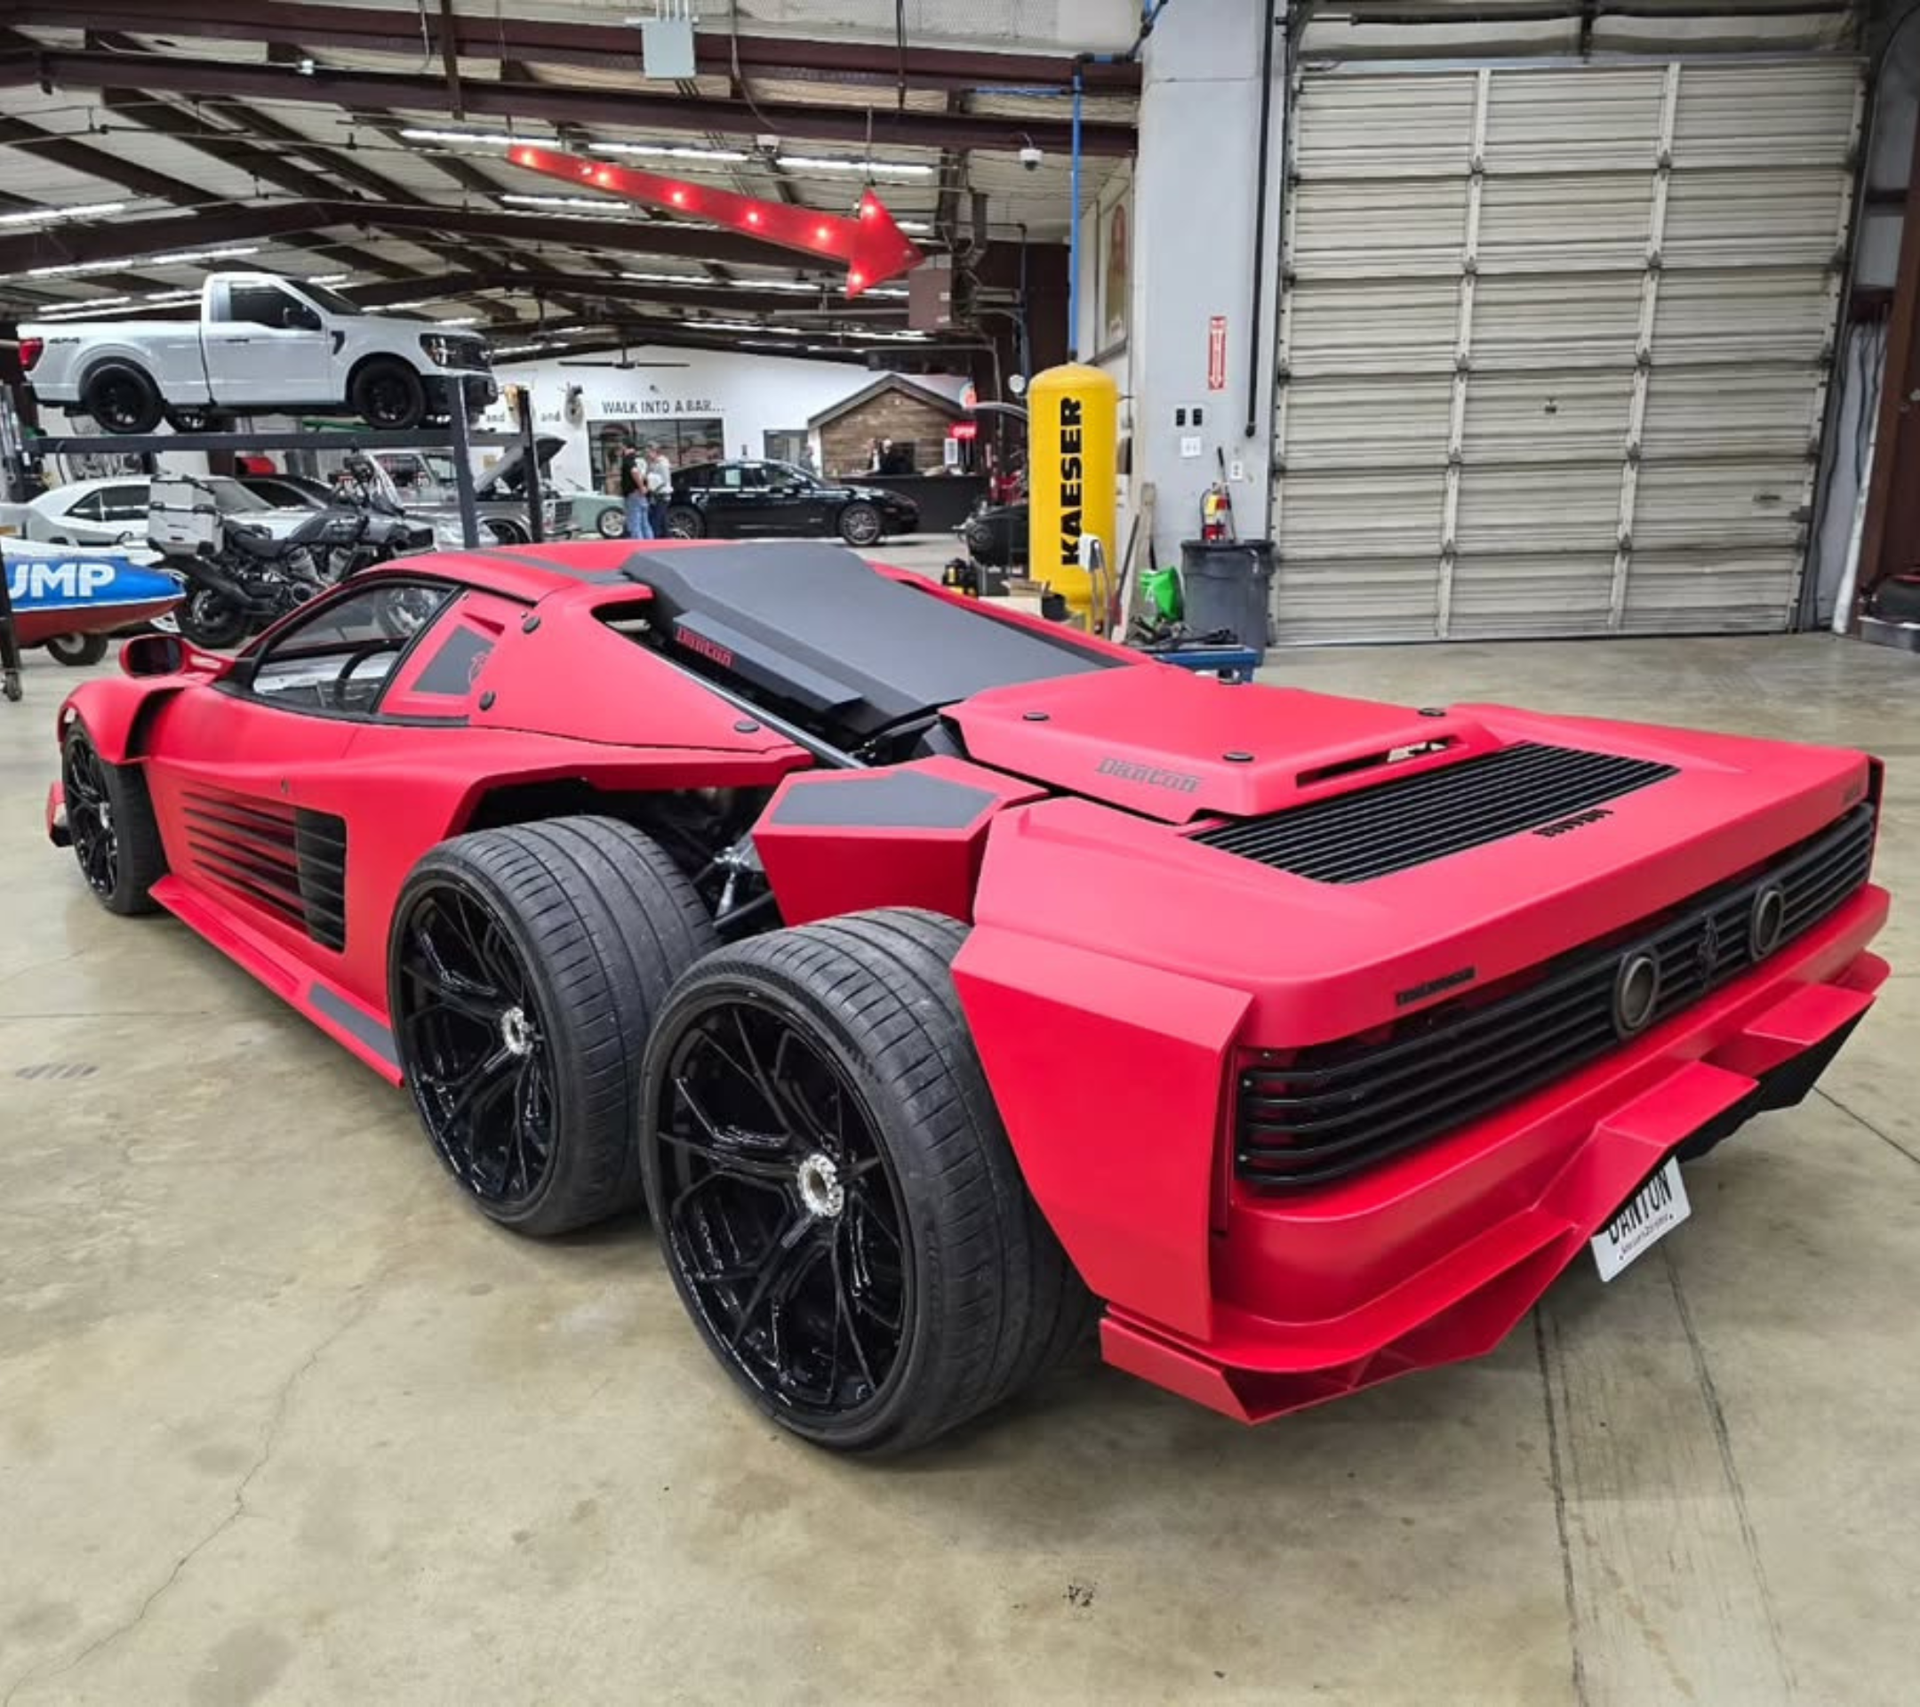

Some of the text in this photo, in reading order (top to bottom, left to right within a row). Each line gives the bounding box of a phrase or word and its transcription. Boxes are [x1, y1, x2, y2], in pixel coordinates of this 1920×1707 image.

[602, 401, 638, 414] WALK
[641, 400, 669, 414] INTO
[674, 400, 684, 412] A
[1060, 397, 1082, 565] KAESER
